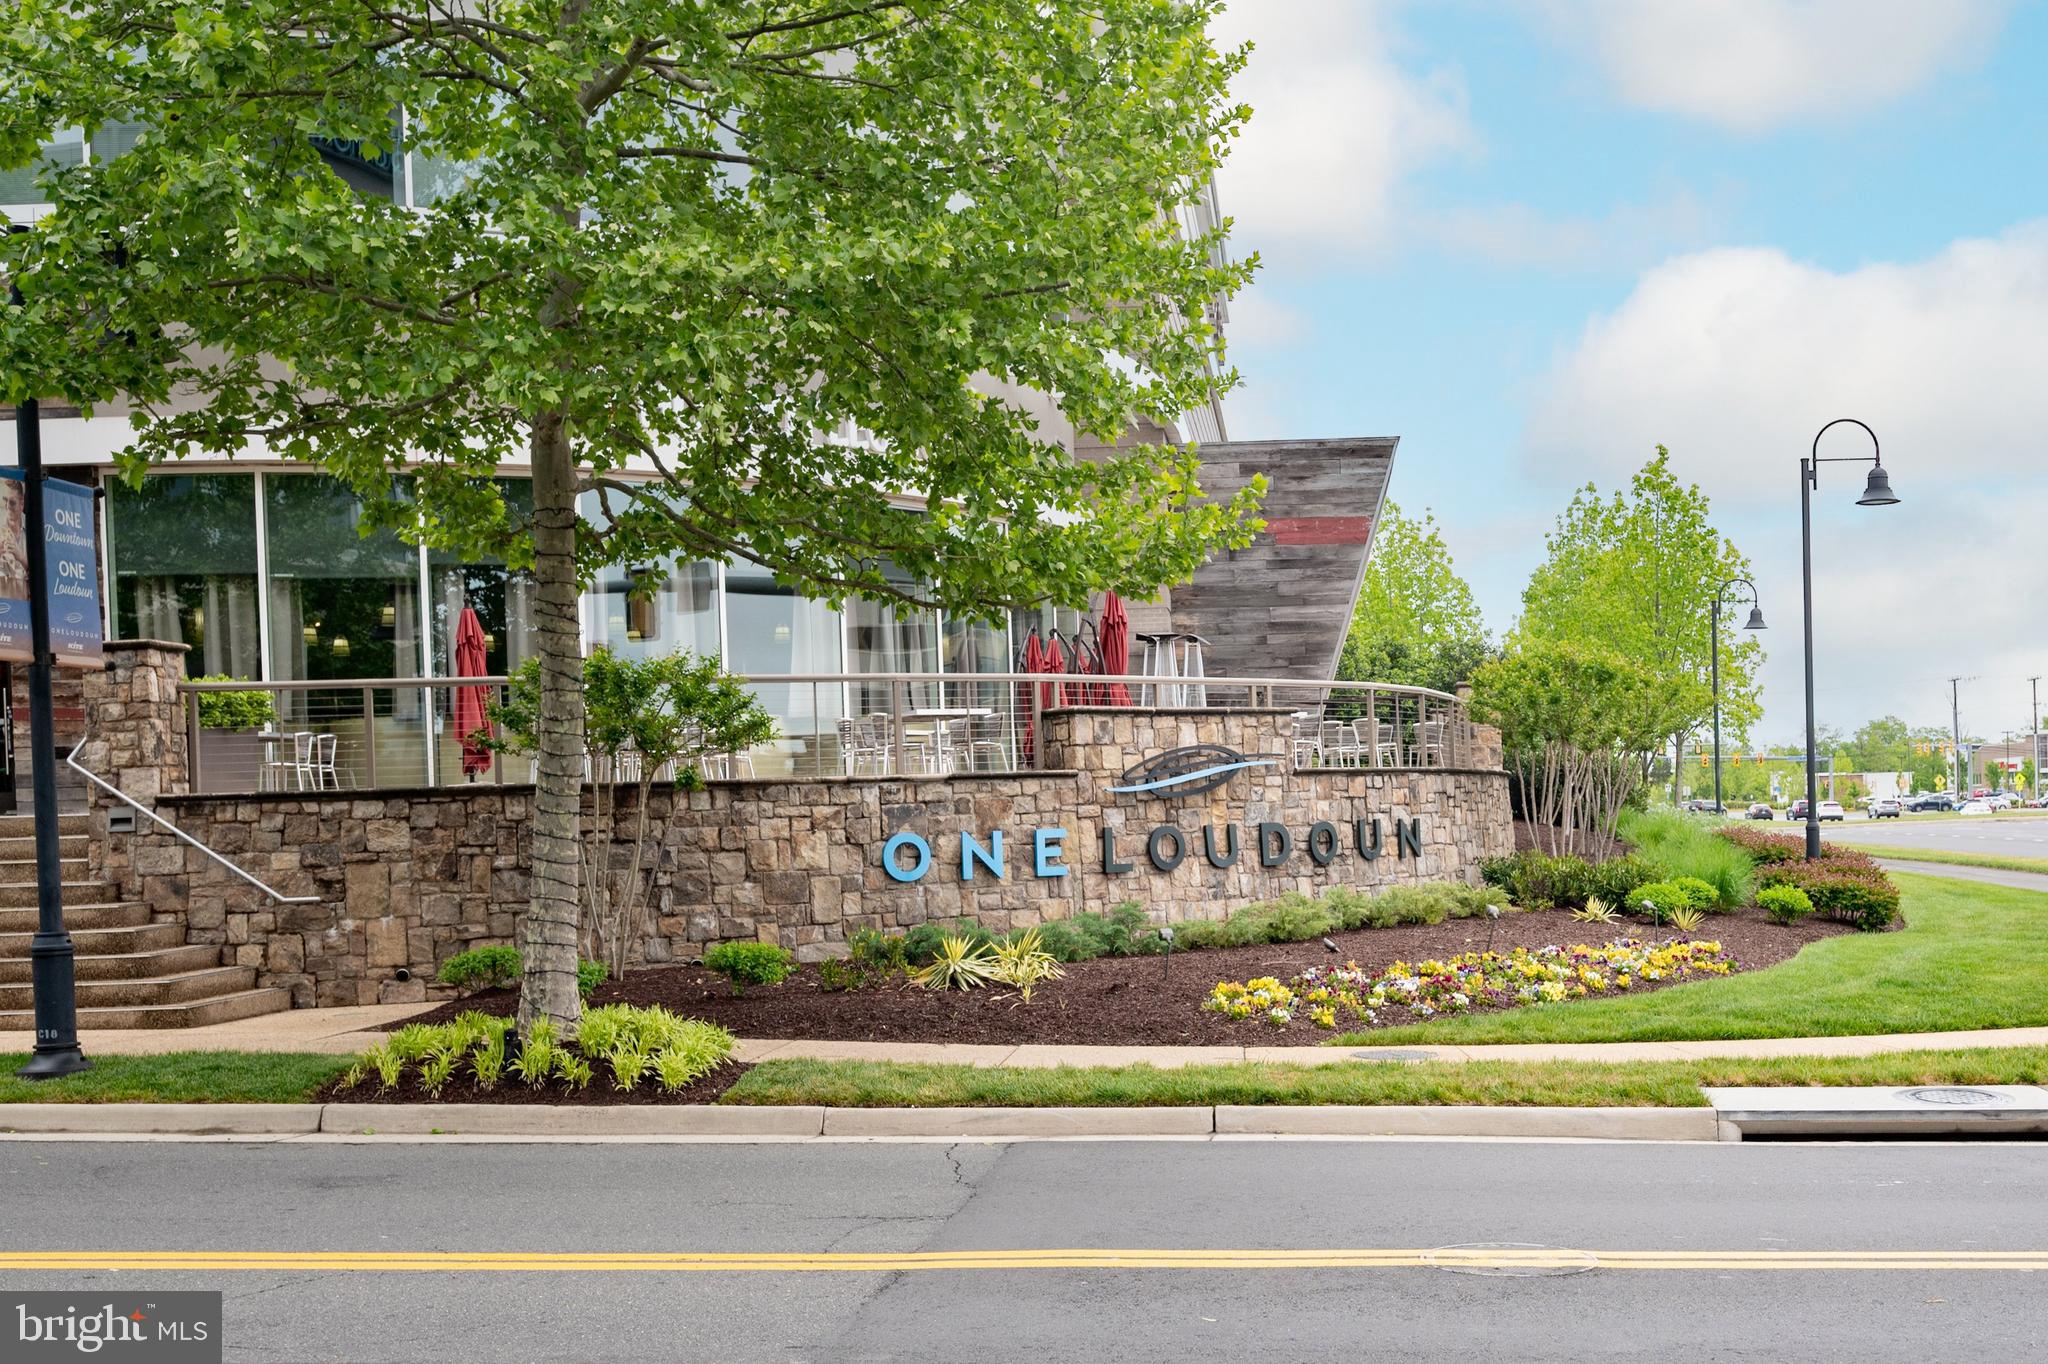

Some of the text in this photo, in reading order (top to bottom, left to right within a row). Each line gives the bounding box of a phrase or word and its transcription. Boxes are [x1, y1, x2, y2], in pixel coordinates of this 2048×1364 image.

[55, 508, 82, 529] ONE
[44, 524, 94, 549] Downtown
[59, 560, 86, 580] ONE
[53, 577, 93, 600] Loudoun
[882, 817, 1422, 882] ONE LOUDOUN
